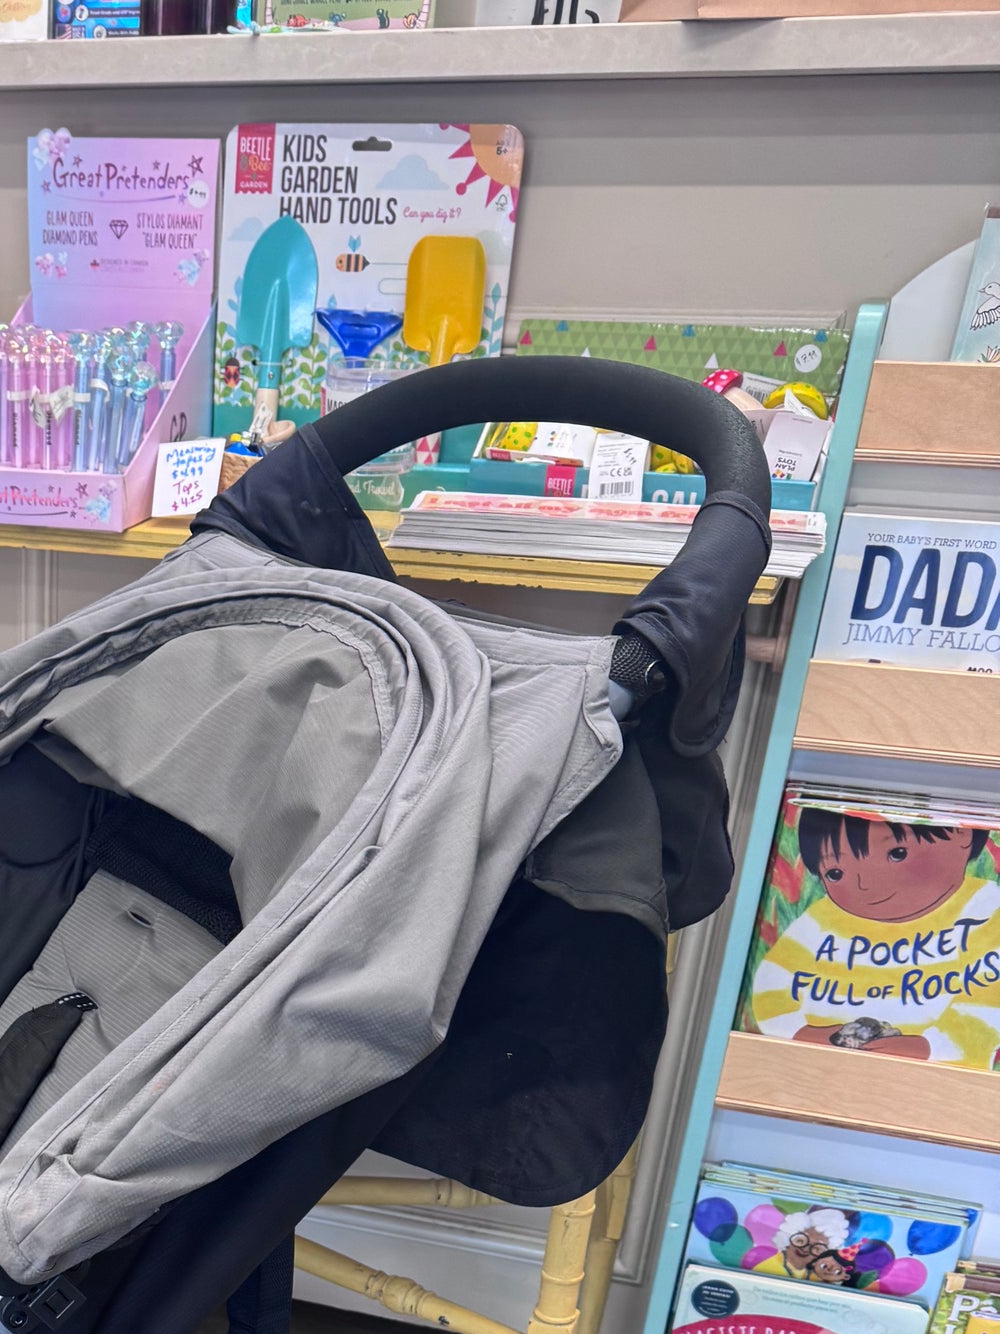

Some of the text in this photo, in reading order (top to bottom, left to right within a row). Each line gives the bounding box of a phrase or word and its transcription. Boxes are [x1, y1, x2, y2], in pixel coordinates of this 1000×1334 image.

[240, 136, 272, 161] BEETLE
[282, 134, 328, 163] KIDS
[53, 157, 190, 190] Great Pretenders
[281, 166, 358, 194] GARDEN
[46, 211, 94, 227] GLAM QUEEN
[137, 213, 203, 230] STYLOS DIAMANT
[280, 196, 398, 225] HAND TOOLS
[403, 206, 419, 218] Can
[420, 210, 435, 223] you
[42, 229, 98, 247] DIAMOND PENS
[166, 446, 217, 463] Measuring
[10, 485, 78, 508] Pretenders
[548, 477, 573, 495] BEETLE
[867, 533, 997, 550] YOUR BABY'S FIRST WORD
[851, 545, 1000, 631] DAD
[842, 623, 922, 646] JIMMY
[816, 918, 990, 971] A POCKET
[791, 951, 1000, 1006] FULL OF ROCKS
